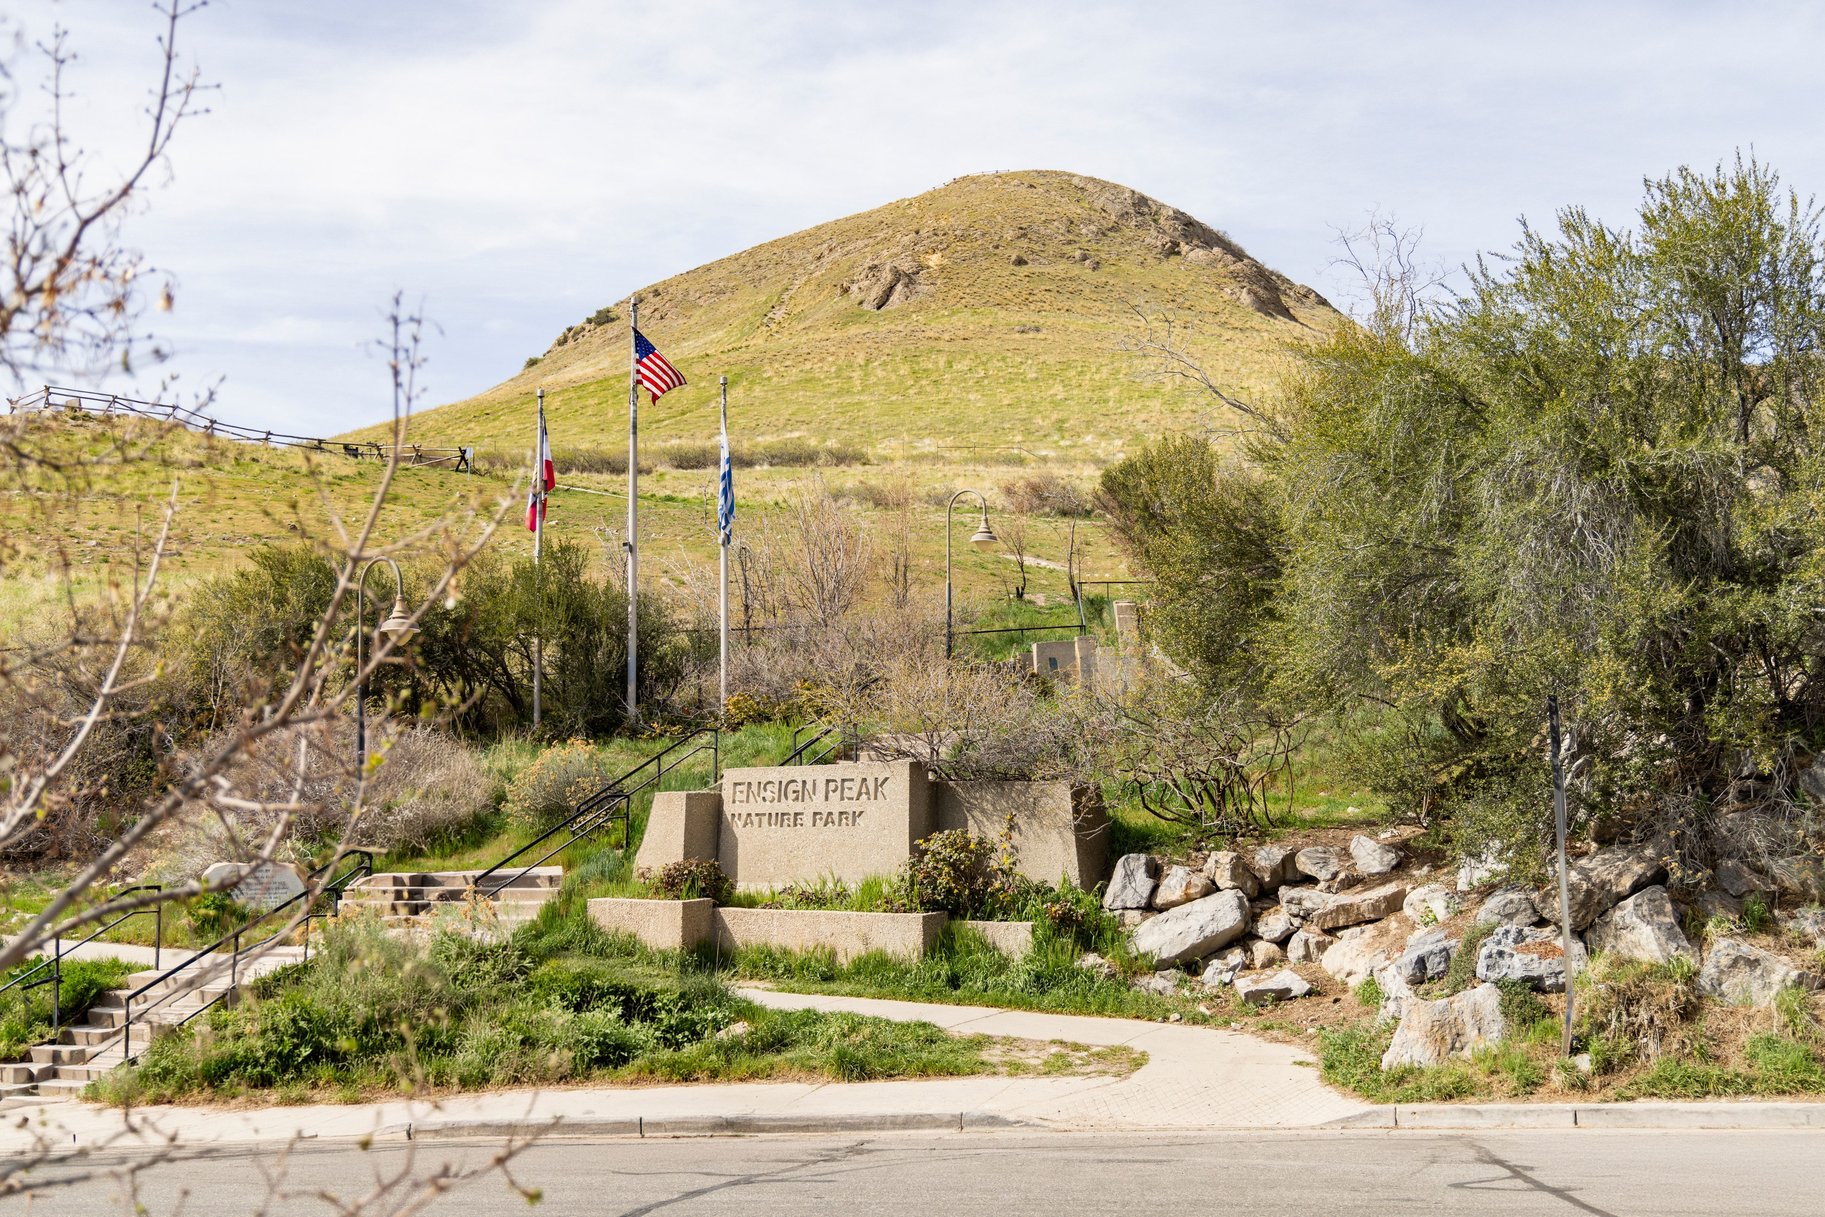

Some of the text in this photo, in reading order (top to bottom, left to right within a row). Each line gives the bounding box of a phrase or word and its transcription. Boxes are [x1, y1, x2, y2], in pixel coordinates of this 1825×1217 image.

[732, 776, 890, 804] ENSIGN PEAK
[730, 810, 865, 829] NATURE PARK
